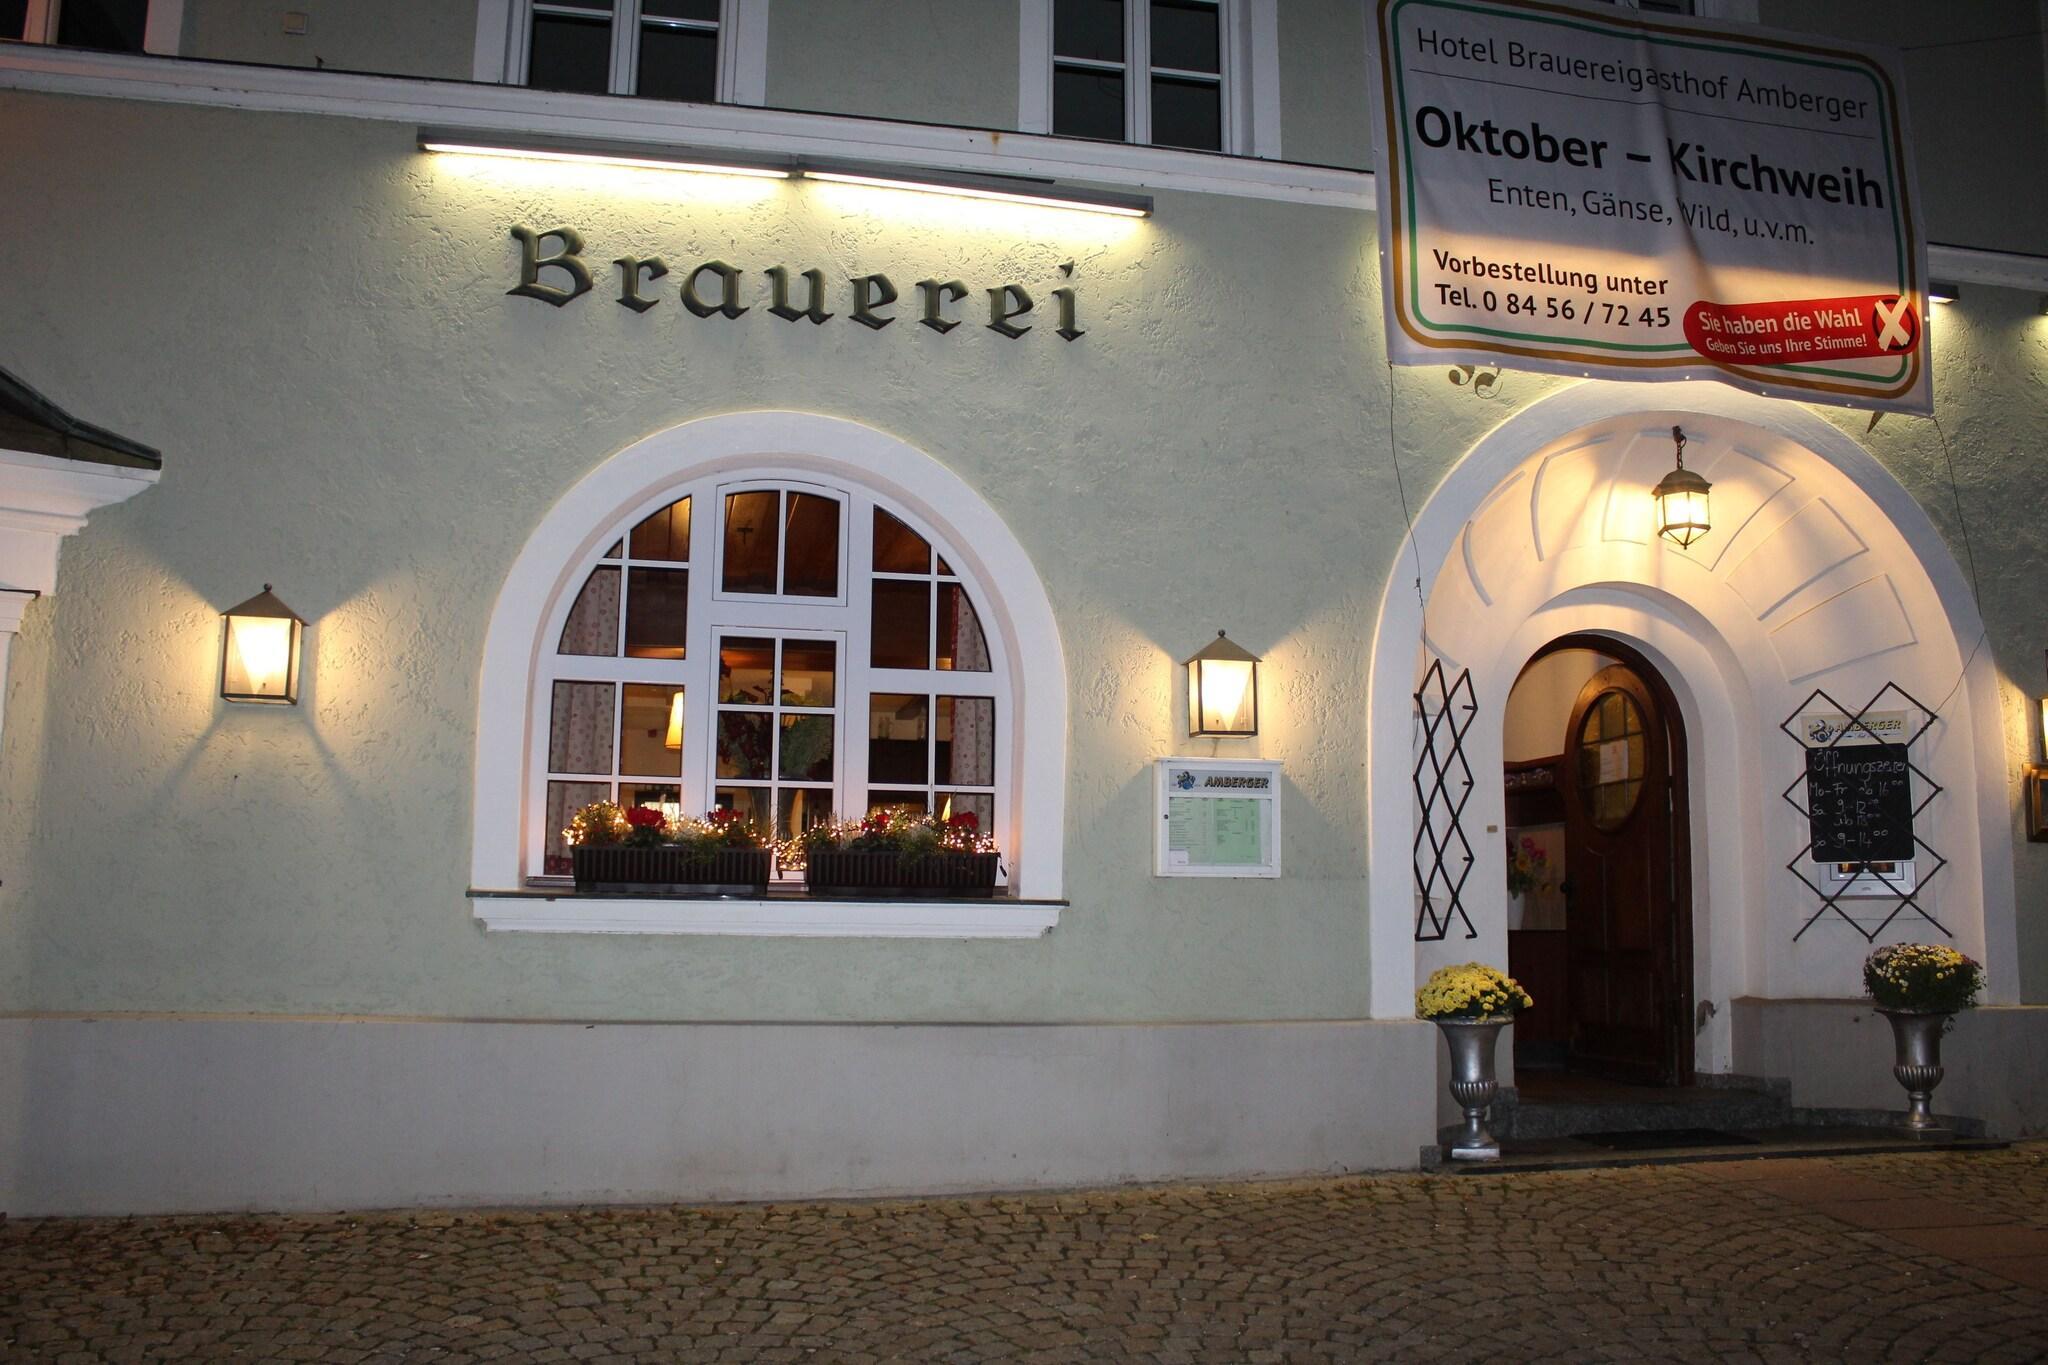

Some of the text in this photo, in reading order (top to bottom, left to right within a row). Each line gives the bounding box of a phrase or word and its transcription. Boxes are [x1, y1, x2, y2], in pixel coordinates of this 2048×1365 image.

[1417, 28, 1868, 121] Hotel Brauereigasthof Amberger
[1415, 106, 1608, 168] Oktober
[1667, 137, 1884, 208] Kirchweih
[1488, 178, 1576, 217] Enten,
[1583, 190, 1673, 225] Gänse,
[1744, 216, 1815, 245] u.v.m.
[505, 222, 1086, 342] Brauerei
[1433, 249, 1668, 295] Vorbestellung unter
[1434, 283, 1670, 328] Tel. 0 84 56 / 72 45
[1699, 308, 1863, 335] Sie haben die Wahl
[1706, 333, 1868, 356] Geben Sie uns Ihre Stimme!
[1204, 776, 1269, 789] AMBERGER
